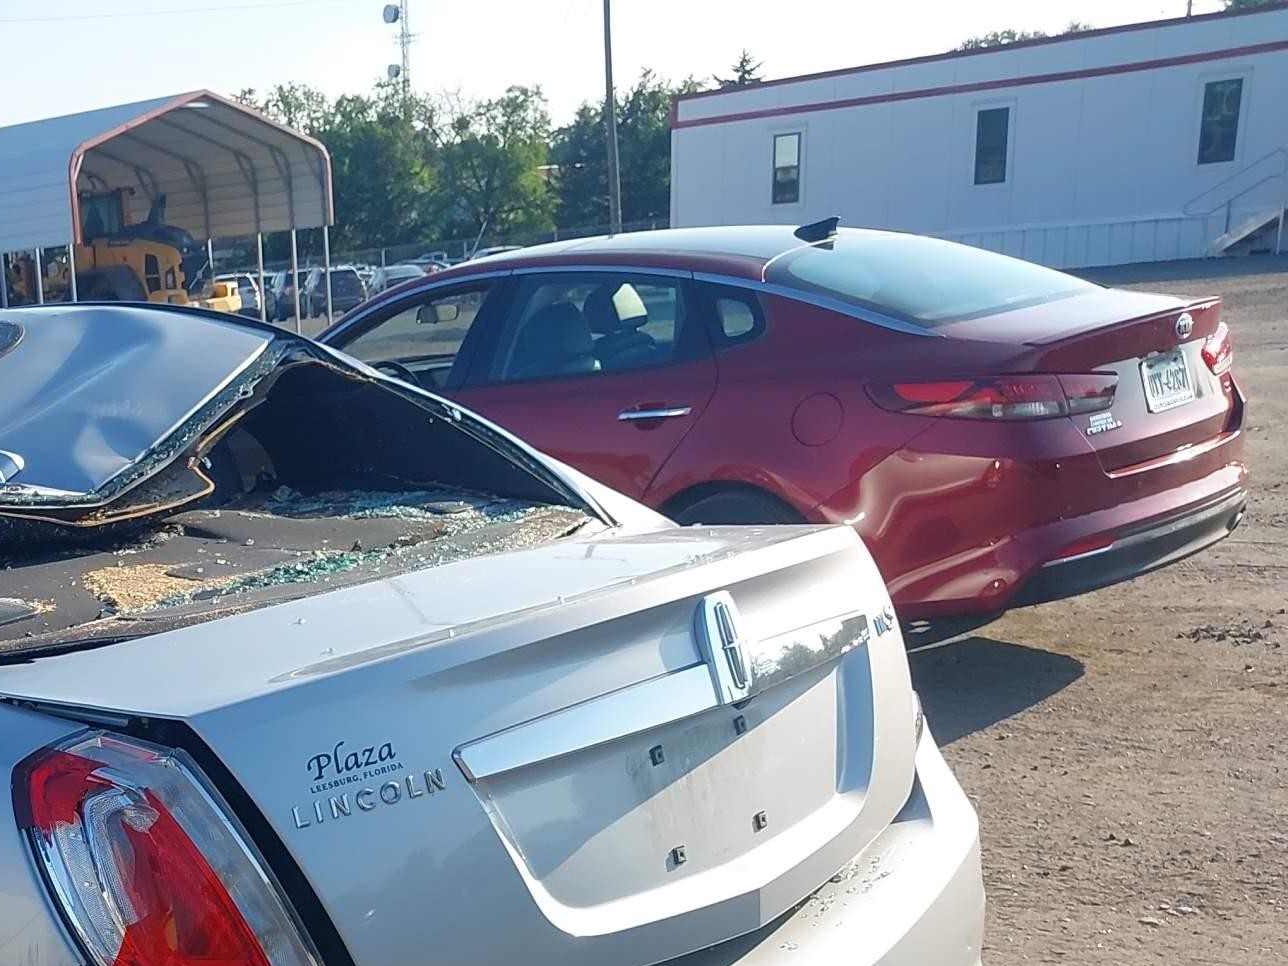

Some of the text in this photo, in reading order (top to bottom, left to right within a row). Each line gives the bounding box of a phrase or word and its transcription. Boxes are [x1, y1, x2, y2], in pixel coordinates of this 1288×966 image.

[307, 741, 396, 781] Plaza
[363, 762, 404, 780] FLORIDA
[291, 768, 446, 829] LINCOLN
